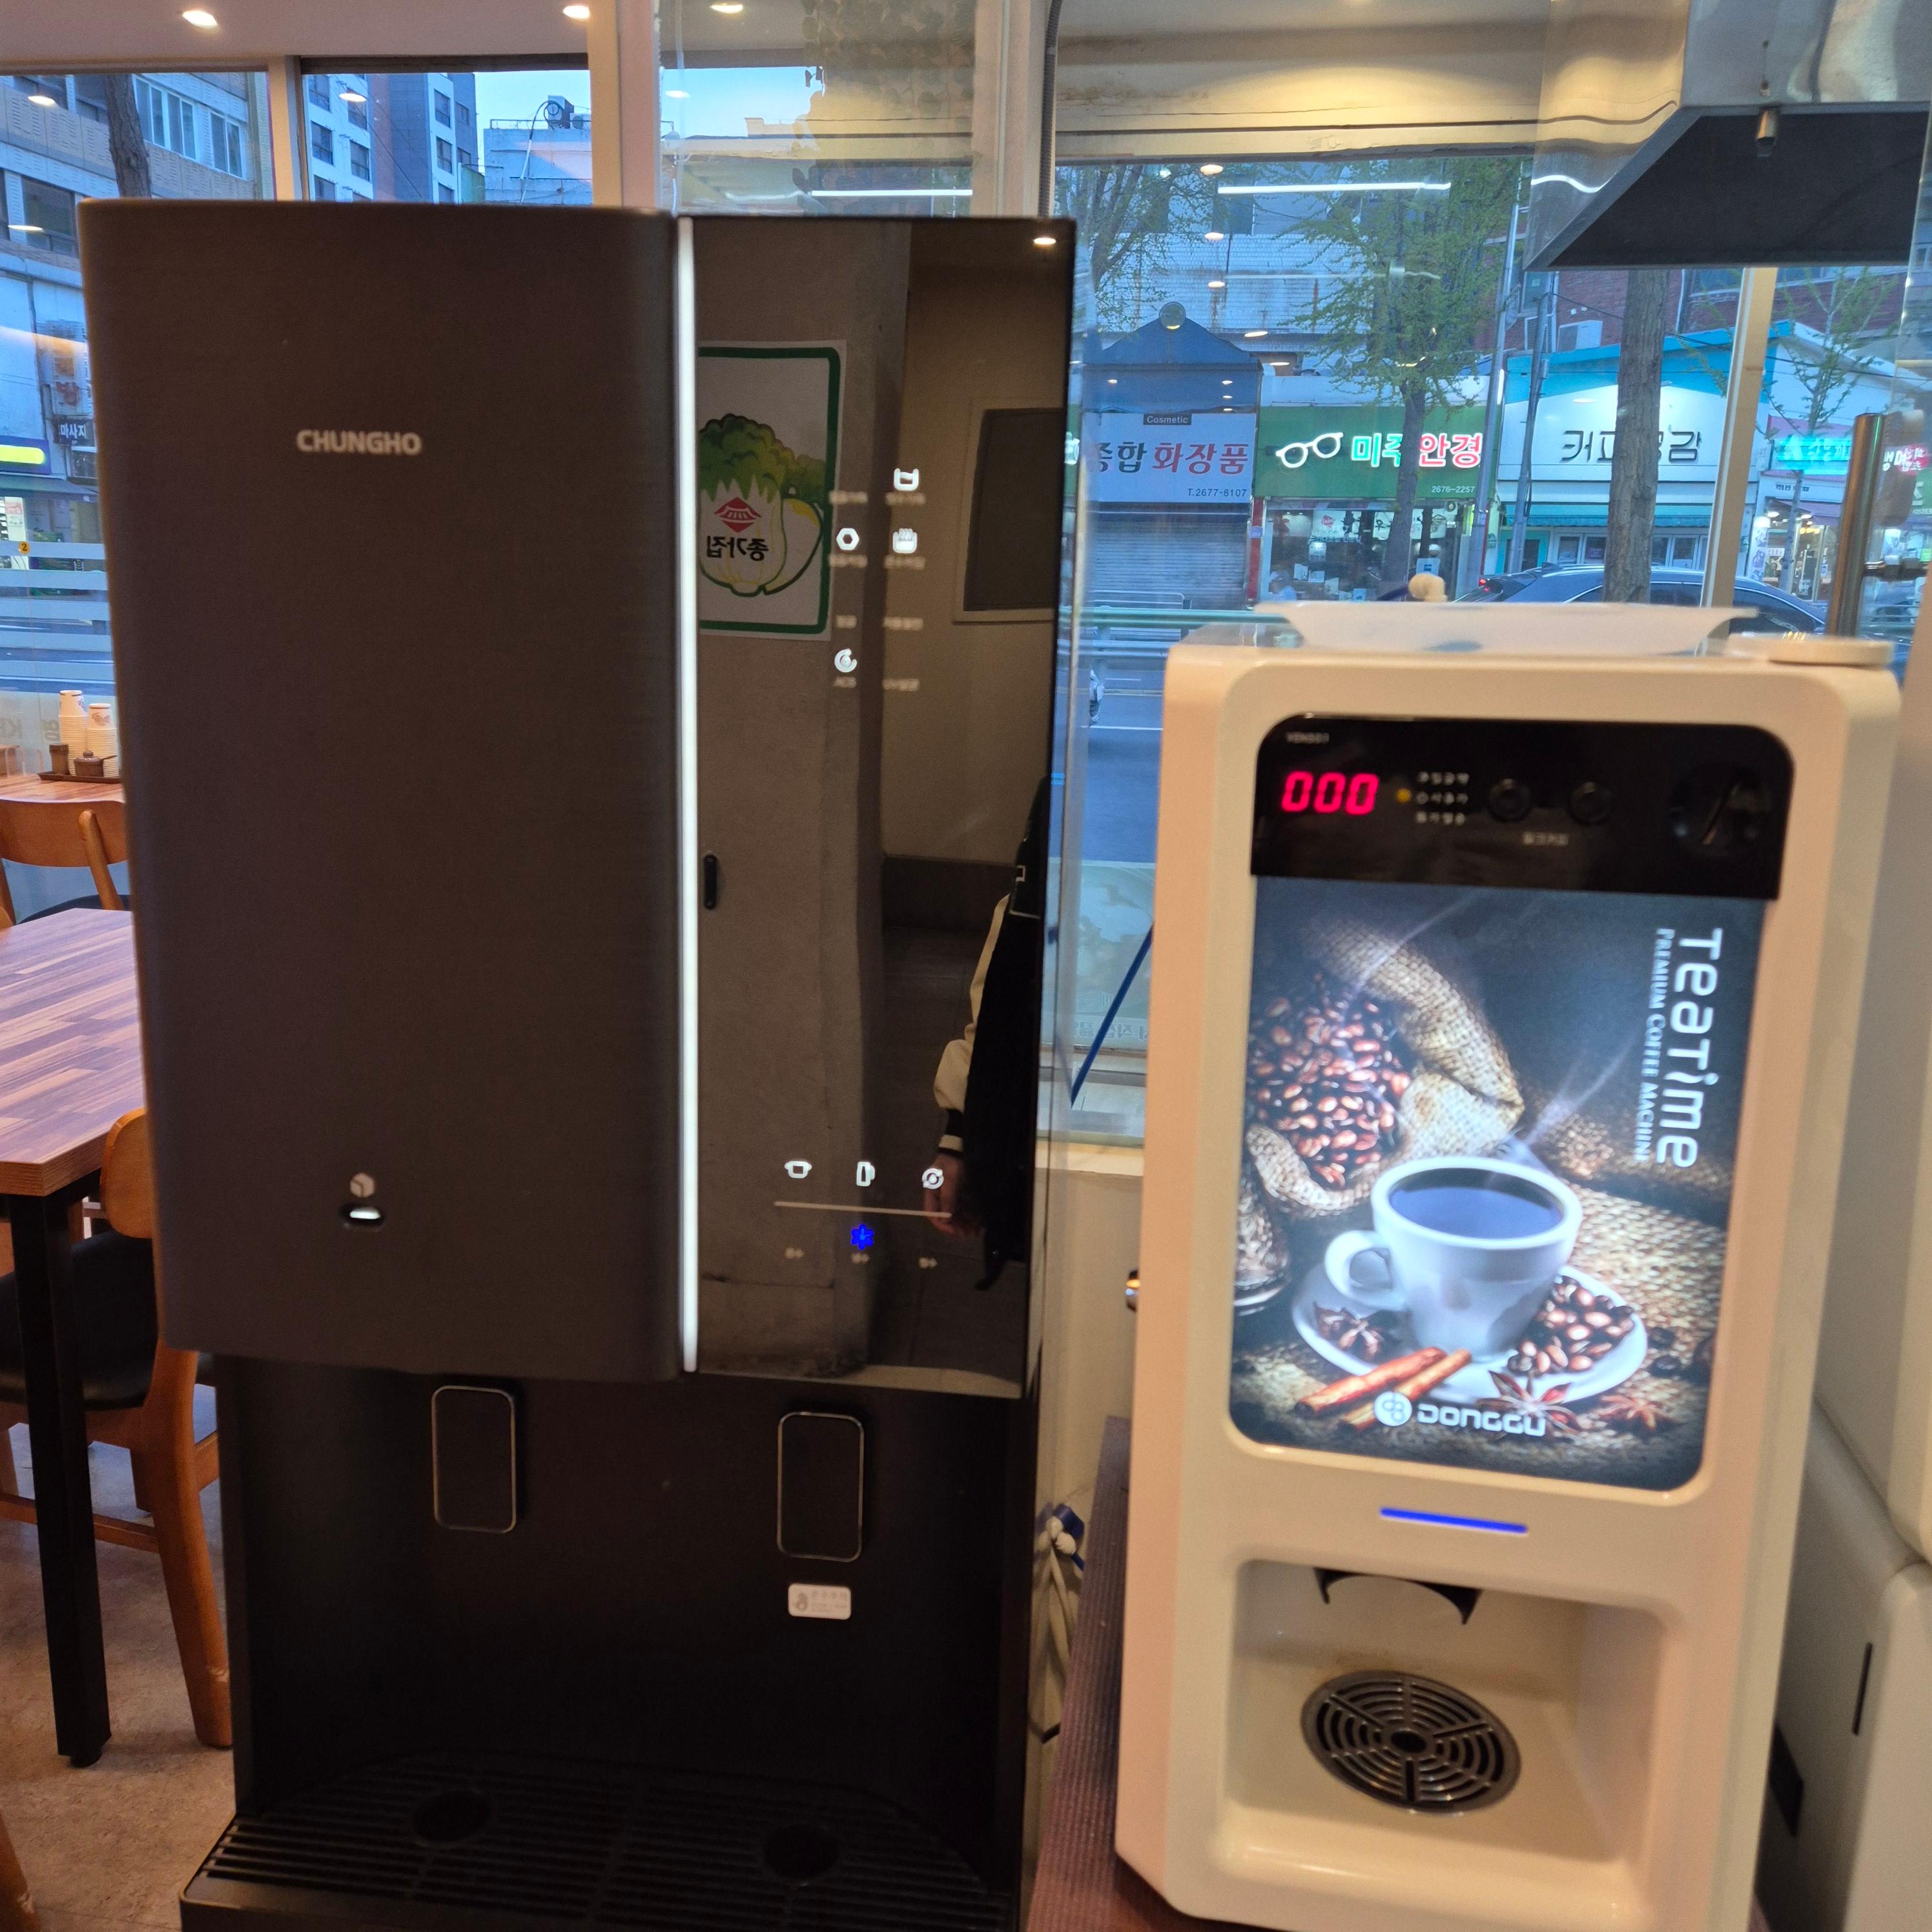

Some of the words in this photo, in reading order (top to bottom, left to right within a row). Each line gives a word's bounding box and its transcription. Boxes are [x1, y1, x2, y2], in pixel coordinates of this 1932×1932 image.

[1146, 415, 1188, 424] Cosmetic
[296, 429, 423, 456] CHUNGHO
[1152, 442, 1249, 475] 화장품
[1419, 433, 1483, 469] 안경
[1561, 430, 1703, 463] 커감
[1281, 771, 1379, 816] 000
[1649, 928, 1676, 1009] PREMIUM
[1641, 1013, 1666, 1078] COFFEE
[1632, 1082, 1659, 1162] MACHINE
